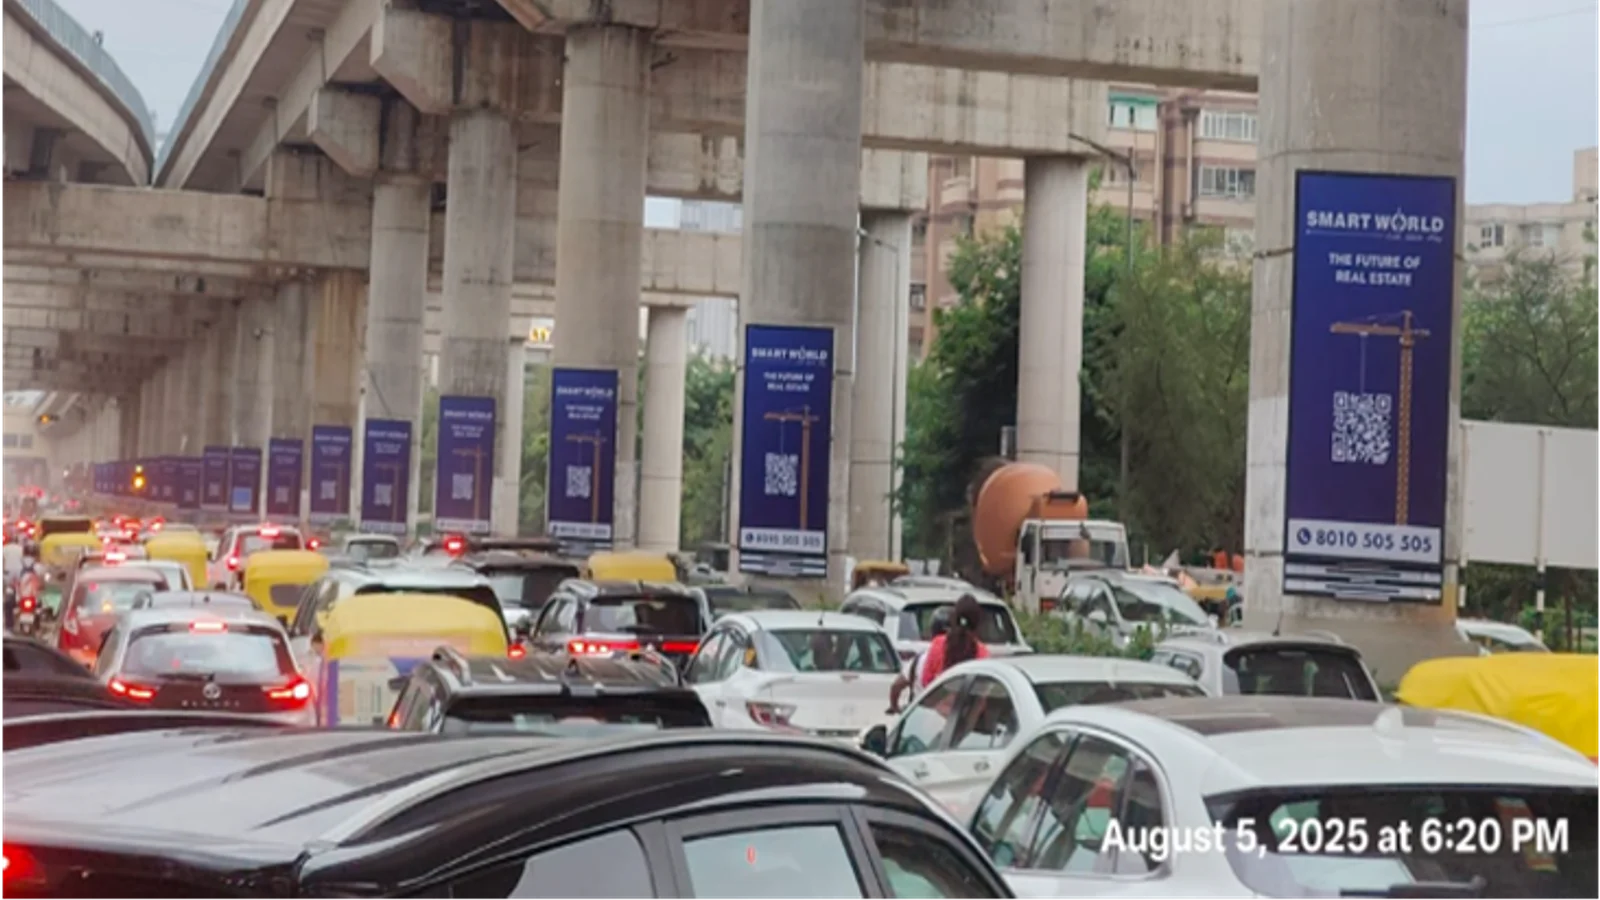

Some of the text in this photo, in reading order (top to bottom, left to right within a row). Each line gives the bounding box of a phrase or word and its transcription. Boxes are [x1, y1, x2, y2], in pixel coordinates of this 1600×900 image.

[1306, 210, 1444, 232] SMART WORLD
[1329, 252, 1421, 270] THE FUTURE OF
[1335, 270, 1413, 286] REAL ESTATE
[751, 346, 828, 360] SMART WORLD
[1315, 529, 1433, 553] 8010 505 505
